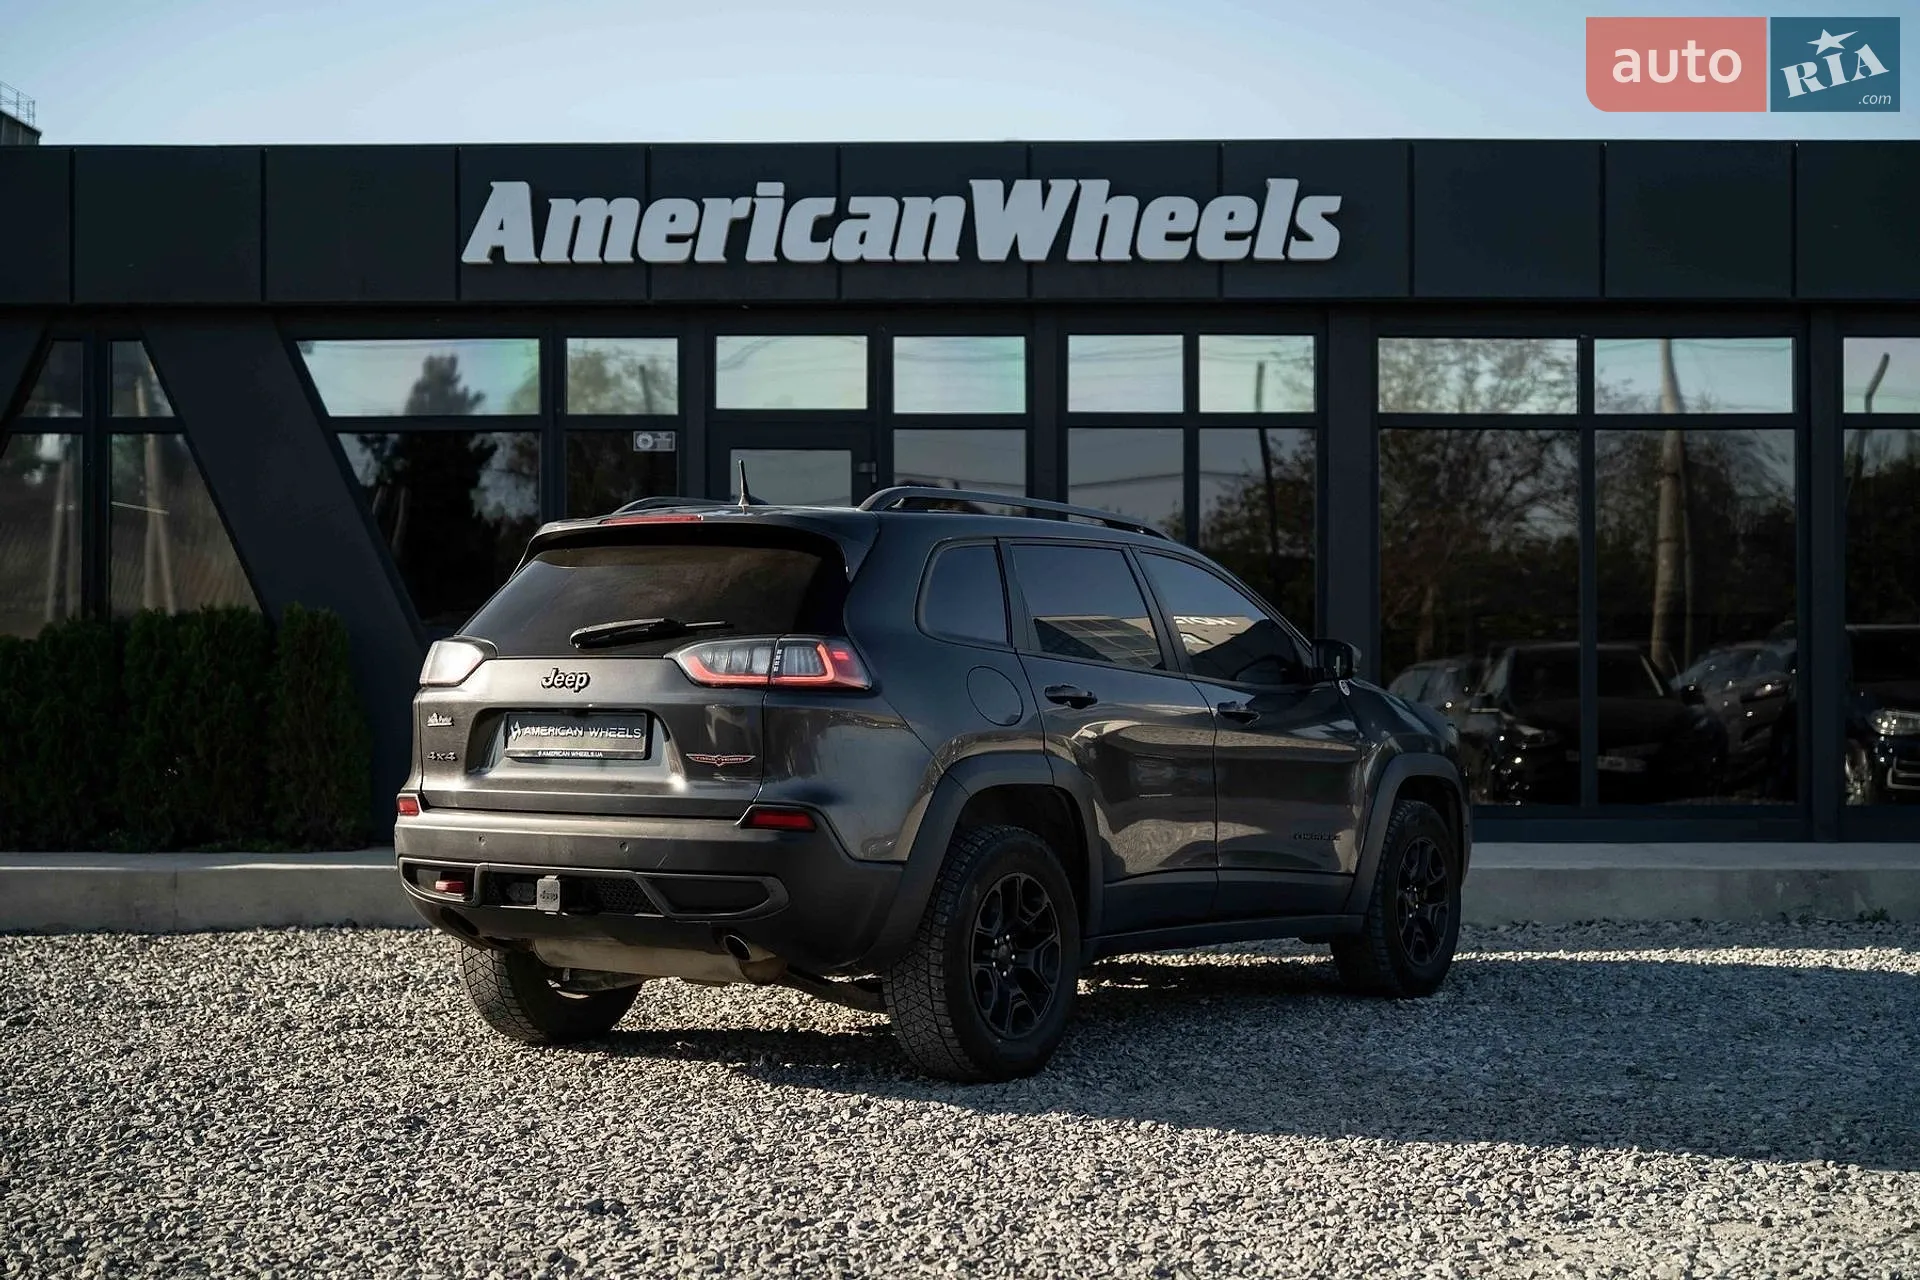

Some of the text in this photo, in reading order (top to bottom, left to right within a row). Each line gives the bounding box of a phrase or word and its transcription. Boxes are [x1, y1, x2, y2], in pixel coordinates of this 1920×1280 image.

[461, 178, 1343, 264] AmericanWheels
[541, 668, 591, 693] Jeep
[522, 726, 642, 739] AMERICAN WHEELS
[427, 751, 457, 760] 4x4
